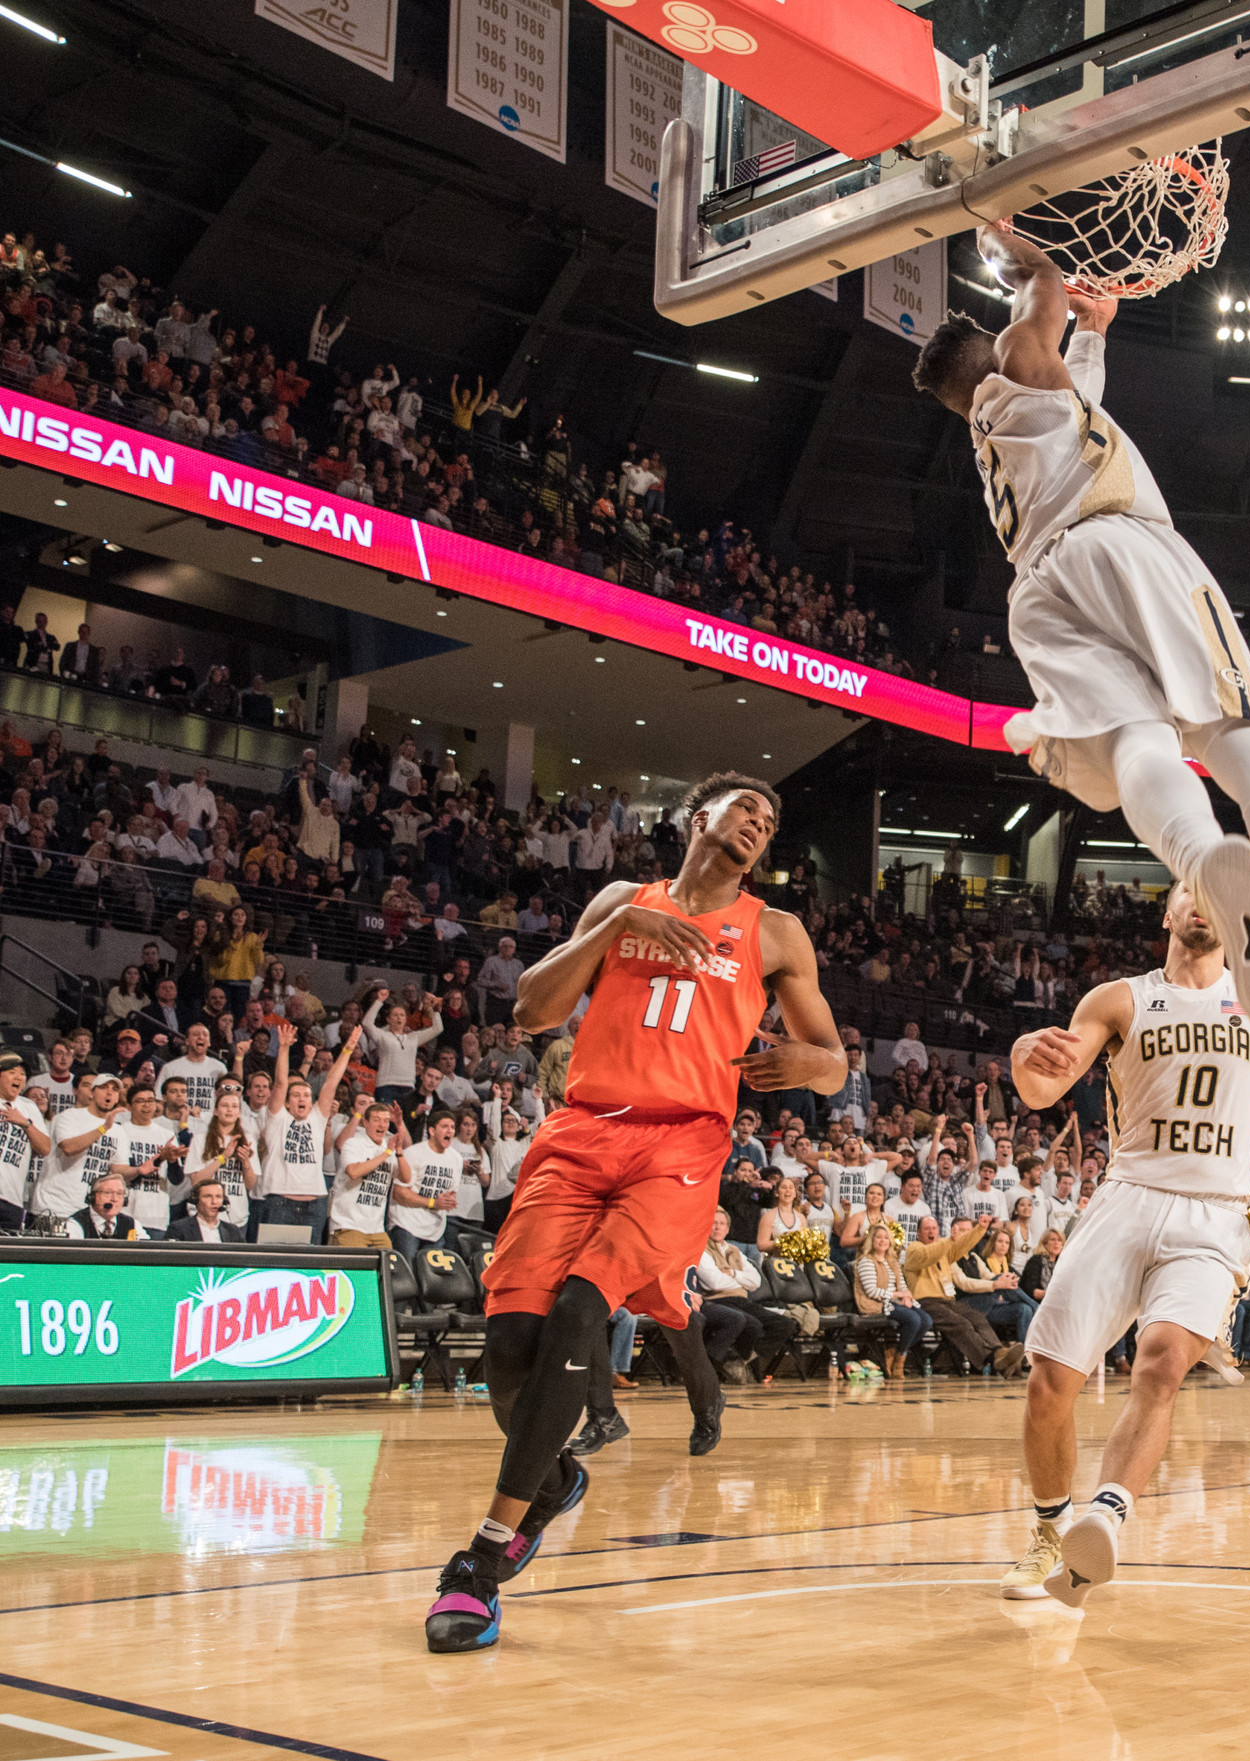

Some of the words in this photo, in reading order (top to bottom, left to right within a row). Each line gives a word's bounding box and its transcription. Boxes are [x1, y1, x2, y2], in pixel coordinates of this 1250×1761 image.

[299, 7, 358, 41] ACC
[515, 10, 545, 40] 1988
[477, 15, 506, 45] 1985
[515, 36, 545, 65] 1989
[475, 41, 506, 72] 1986
[514, 62, 545, 92] 1990
[645, 62, 682, 93] APPEARAN
[475, 68, 505, 98] 1987
[513, 88, 541, 118] 1991
[629, 73, 656, 102] 1992
[629, 98, 656, 126] 1993
[629, 124, 657, 151] 1996
[630, 149, 657, 176] 2001
[893, 255, 921, 284] 1990
[892, 283, 923, 314] 2004
[209, 470, 373, 548] NISSAN
[685, 618, 749, 662] TAKE
[752, 642, 788, 675] ON
[792, 653, 868, 697] TODAY
[365, 916, 384, 930] 109
[641, 974, 698, 1034] 11
[1140, 1022, 1250, 1063] GEORGIA
[1175, 1064, 1220, 1109] 10
[1150, 1118, 1234, 1159] TECH
[420, 1176, 435, 1187] AIR
[425, 1165, 438, 1177] AIR
[418, 1186, 434, 1198] AIR
[15, 1299, 120, 1356] 1896
[172, 1275, 340, 1375] LIBMAN
